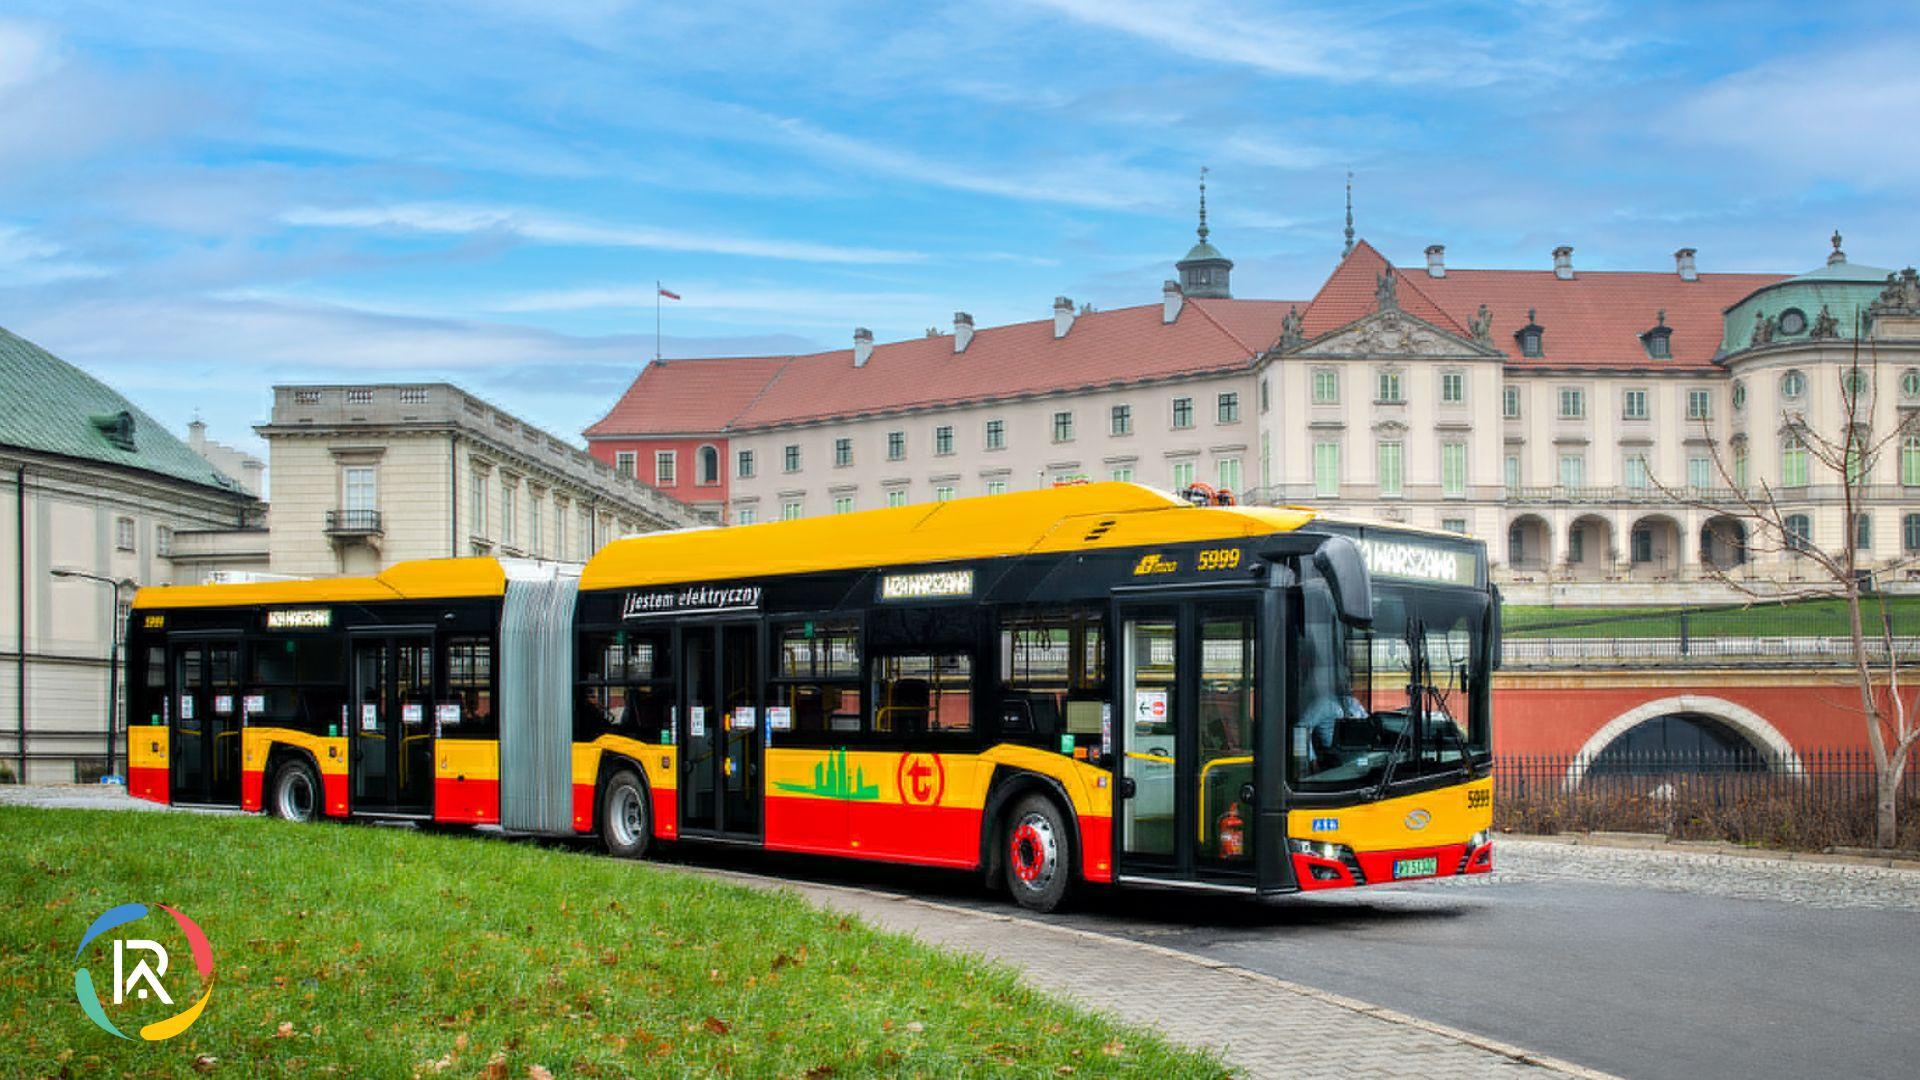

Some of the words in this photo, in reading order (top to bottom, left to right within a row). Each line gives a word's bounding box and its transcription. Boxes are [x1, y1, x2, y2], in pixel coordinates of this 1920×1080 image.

[1197, 548, 1240, 571] 5999
[1373, 541, 1457, 581] WARSZAWA
[679, 587, 761, 607] elektryczny
[1467, 789, 1490, 809] 5999
